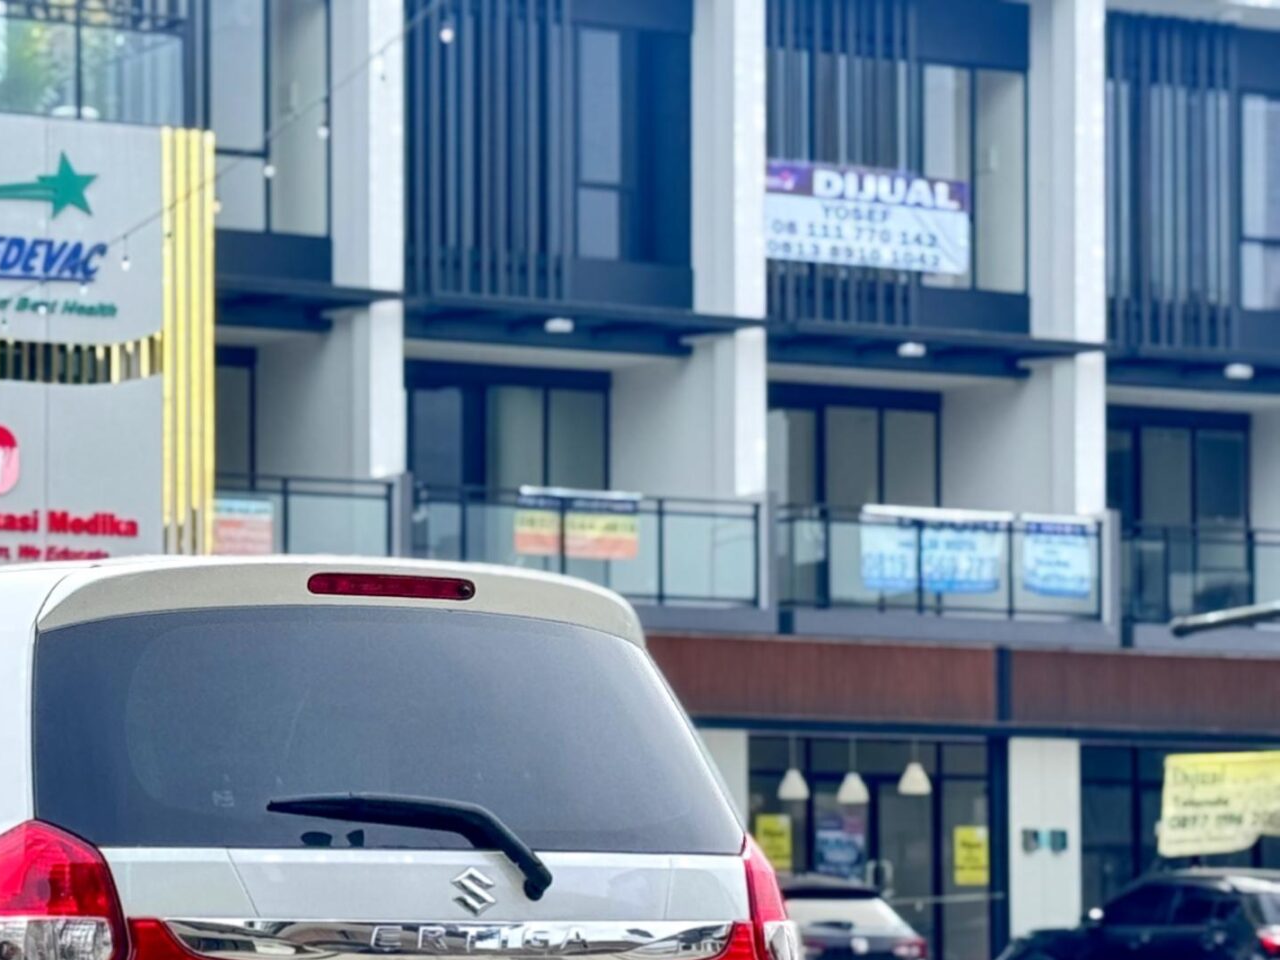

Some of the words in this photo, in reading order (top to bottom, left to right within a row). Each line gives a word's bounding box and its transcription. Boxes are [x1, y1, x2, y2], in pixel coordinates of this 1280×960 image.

[813, 169, 960, 211] DIJUAL
[61, 300, 118, 318] Health
[46, 510, 138, 537] Medika
[18, 545, 40, 560] We
[371, 924, 589, 952] ERTIGA
